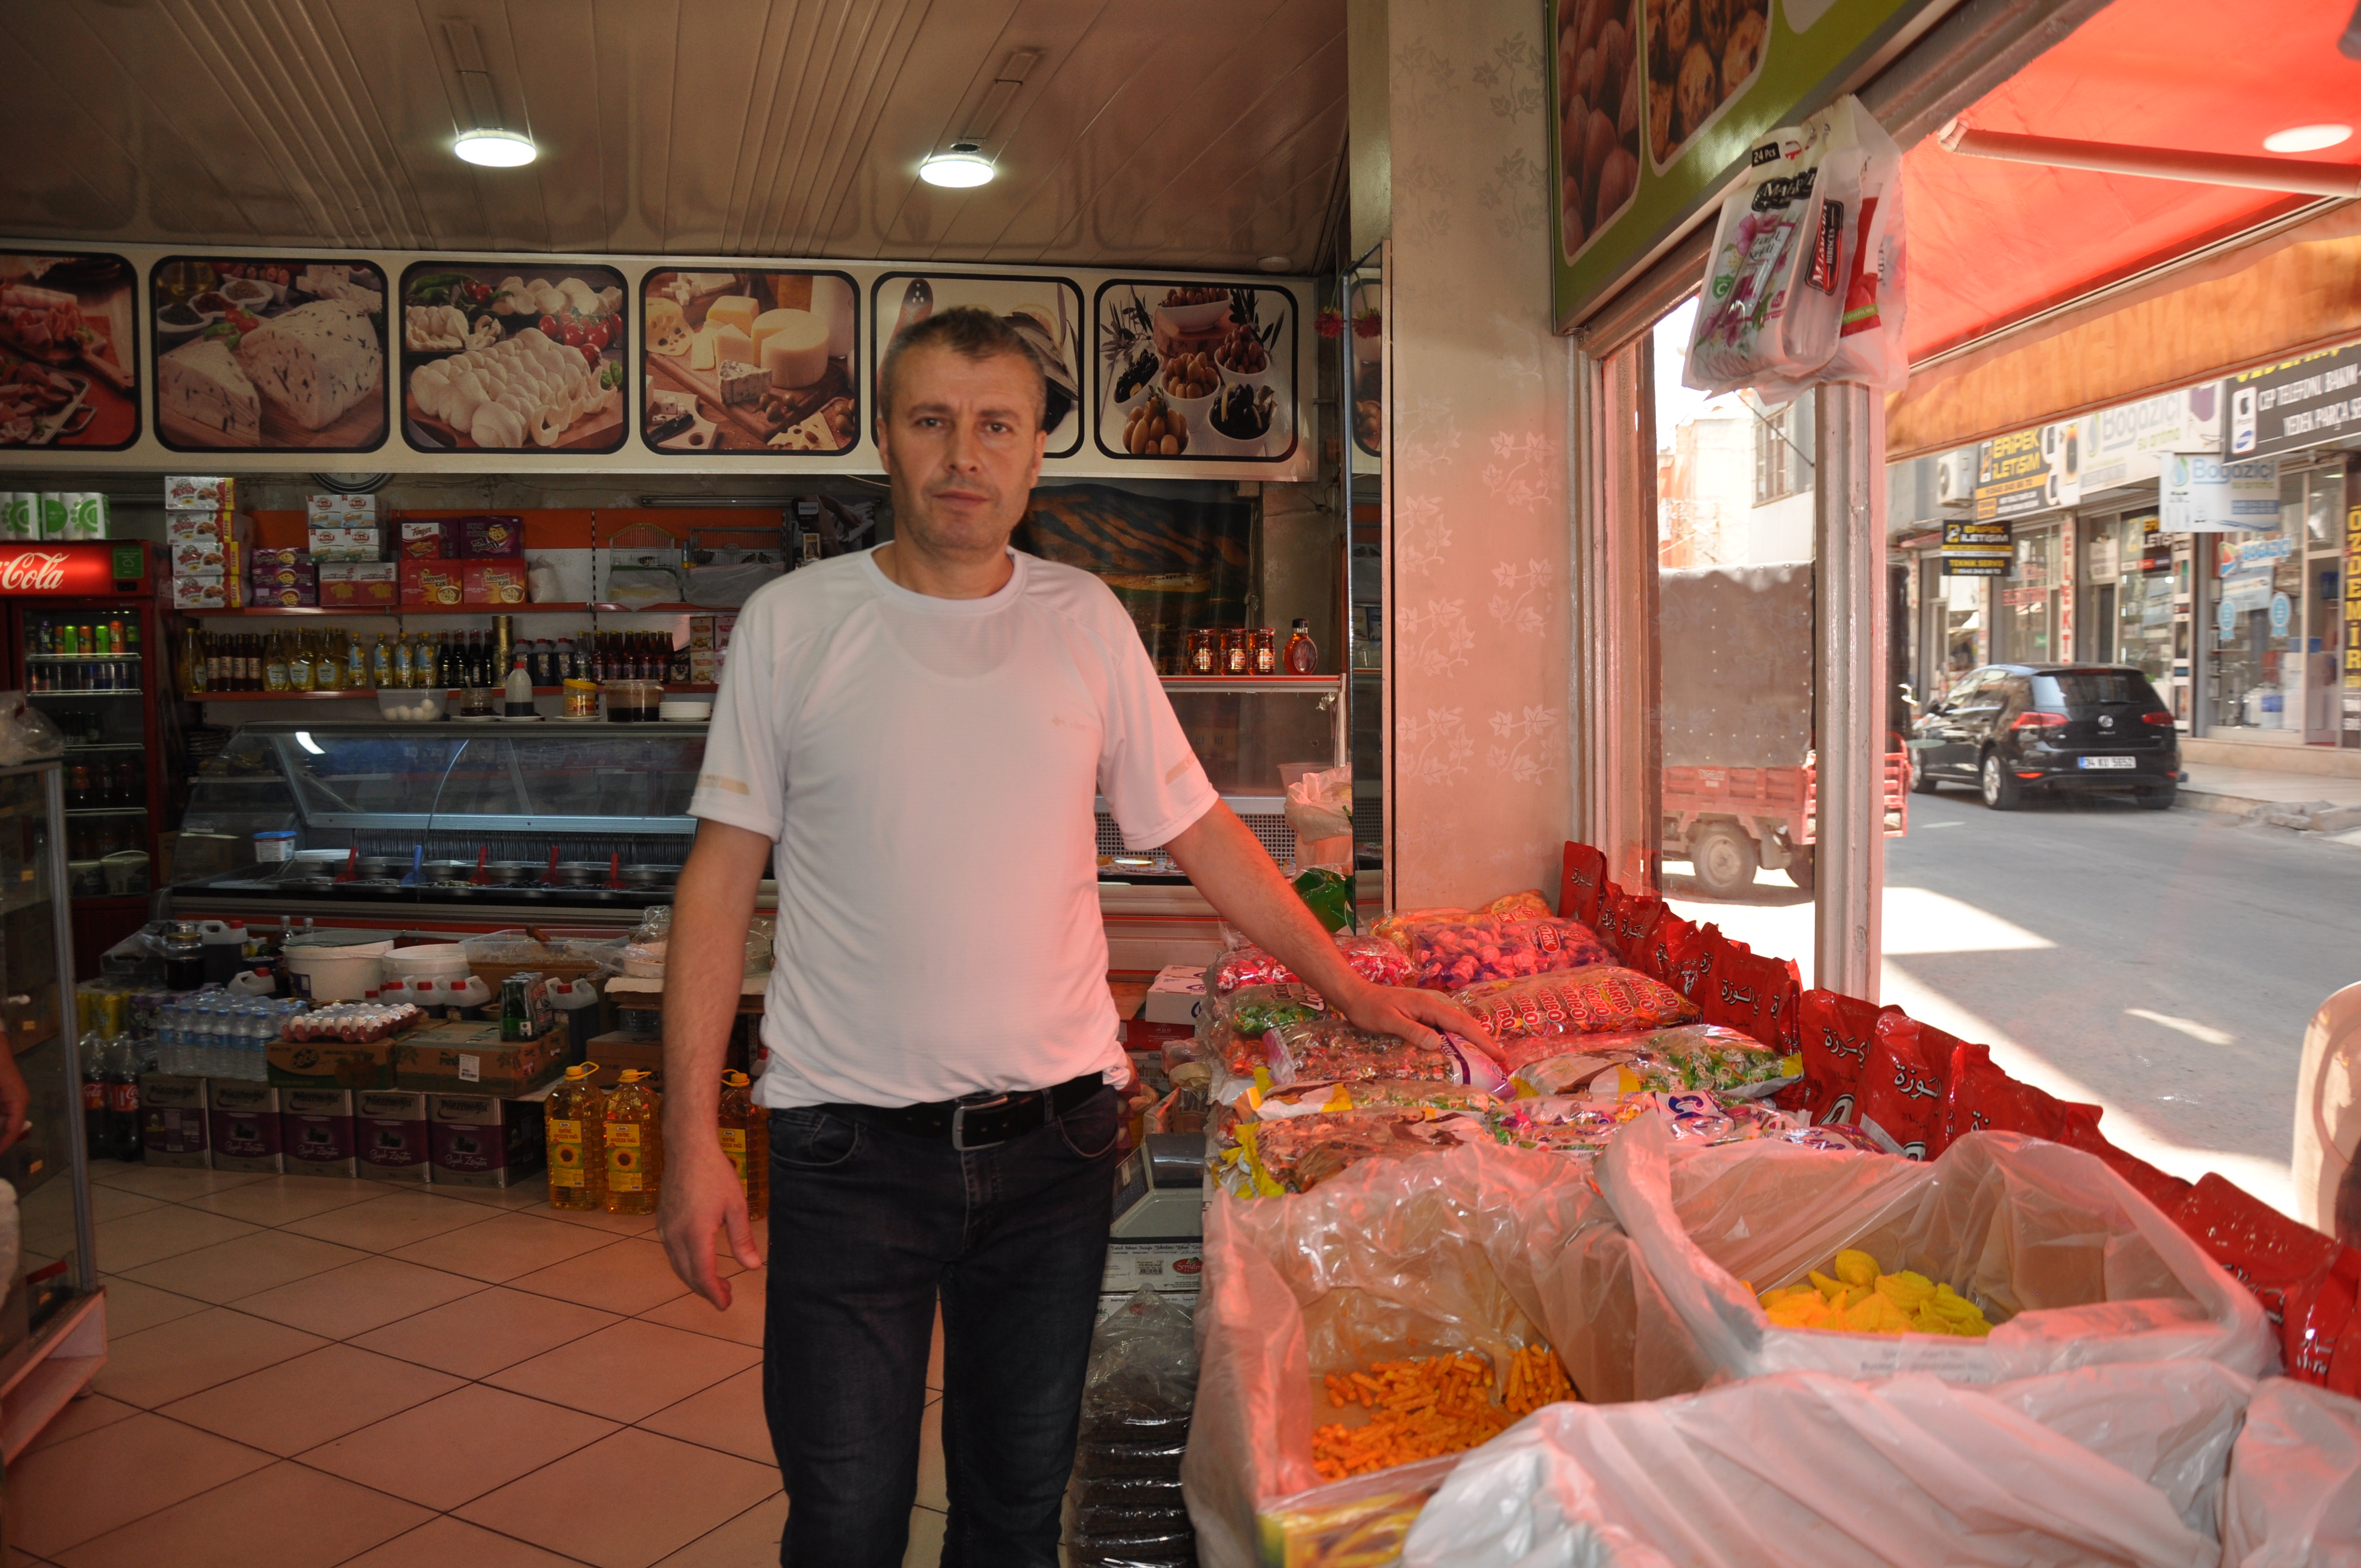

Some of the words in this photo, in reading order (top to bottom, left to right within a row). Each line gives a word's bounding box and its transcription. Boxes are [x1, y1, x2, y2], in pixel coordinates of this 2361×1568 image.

[1754, 151, 1764, 163] 24
[1765, 149, 1776, 159] Pcs
[1826, 227, 1835, 265] HIBISCUS
[2257, 388, 2277, 411] CEP
[1602, 979, 1634, 1015] HARIBO
